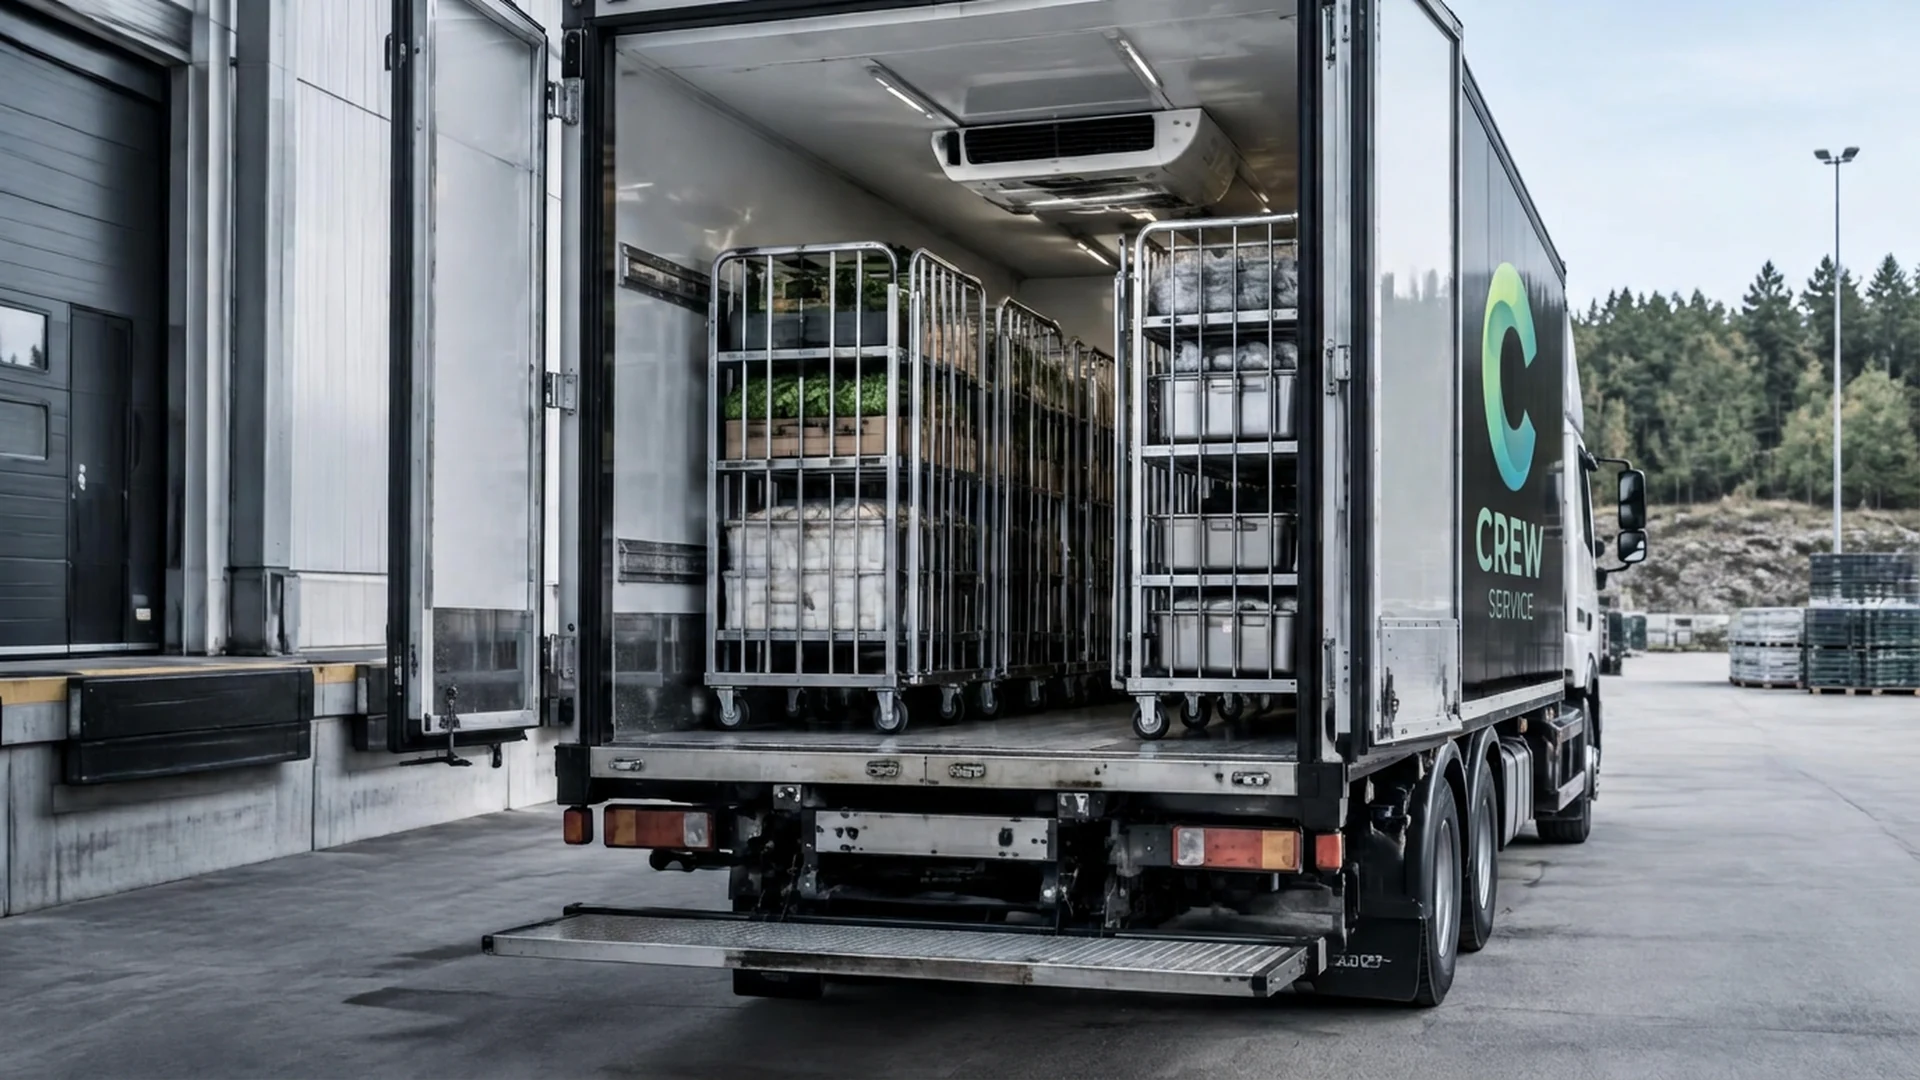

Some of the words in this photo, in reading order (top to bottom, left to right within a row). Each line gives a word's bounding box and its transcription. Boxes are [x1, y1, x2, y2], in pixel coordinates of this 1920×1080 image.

[1482, 262, 1537, 492] C
[1476, 506, 1544, 578] CREW
[1488, 588, 1534, 620] SERVICE
